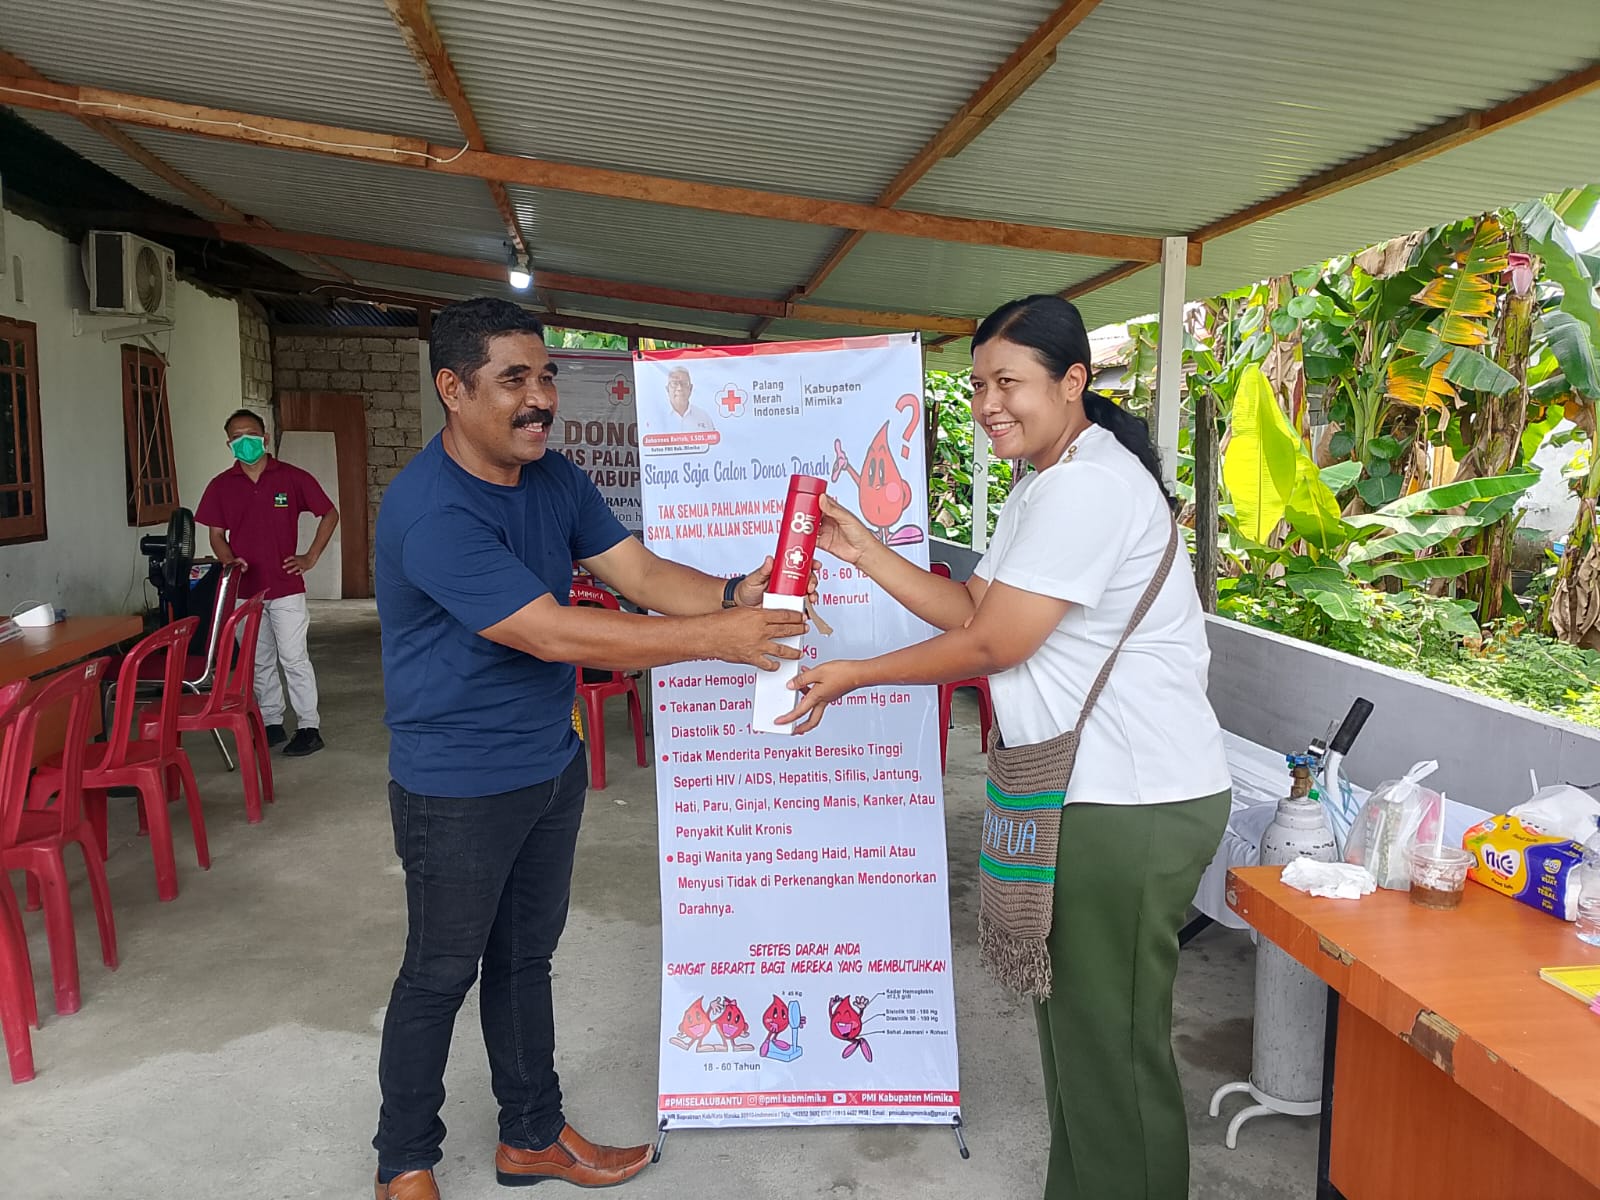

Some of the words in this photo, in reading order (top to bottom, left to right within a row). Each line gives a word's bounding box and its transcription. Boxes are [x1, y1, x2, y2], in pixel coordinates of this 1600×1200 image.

[752, 380, 784, 391] Palang
[753, 394, 782, 404] Merah
[804, 396, 842, 406] Mimika
[754, 405, 800, 416] Indonesia
[645, 463, 679, 489] Siapa
[683, 461, 709, 488] Saja
[714, 460, 747, 482] Calon
[751, 458, 787, 480] Donor
[791, 454, 830, 476] Darah
[658, 505, 675, 519] TAK
[677, 502, 709, 519] SEMUA
[711, 499, 760, 517] PAHLAWAN
[647, 526, 674, 541] SAYA,
[676, 523, 705, 540] KAMU,
[707, 522, 740, 537] KALIAN
[743, 520, 774, 536] SEMUA
[839, 567, 853, 579] 60
[822, 592, 869, 605] Menurut
[802, 645, 817, 659] Kg
[668, 675, 702, 688] Kadar
[705, 672, 757, 688] Hemoglo
[670, 701, 716, 713] Tekanan
[719, 698, 752, 711] Darah
[846, 693, 867, 705] mm
[870, 692, 886, 707] Hg
[889, 691, 910, 704] dan
[672, 724, 719, 738] Diastolik
[722, 723, 736, 736] 50
[672, 751, 703, 763] Tidak
[705, 748, 760, 761] Menderita
[763, 746, 812, 761] Penyakit
[814, 744, 865, 758] Beresiko
[867, 742, 904, 758] Tinggi
[673, 775, 713, 790] Seperti
[715, 774, 736, 786] HIV
[744, 772, 776, 786] AIDS,
[779, 770, 832, 786] Hepatitis,
[834, 769, 870, 783] Sifilis,
[872, 768, 923, 782] Jantung,
[674, 801, 701, 813] Hati,
[703, 800, 732, 812] Paru,
[735, 798, 771, 813] Ginjal,
[773, 796, 820, 811] Kencing
[823, 795, 860, 808] Manis,
[863, 794, 906, 806] Kanker,
[909, 793, 936, 805] Atau
[676, 825, 723, 840] Penyakit
[726, 824, 752, 836] Kulit
[755, 822, 793, 835] Kronis
[983, 808, 1037, 855] PAPUA
[677, 851, 702, 866] Bagi
[704, 850, 742, 863] Wanita
[745, 851, 773, 864] yang
[776, 848, 819, 862] Sedang
[821, 847, 851, 860] Haid,
[853, 845, 887, 858] Hamil
[889, 845, 916, 857] Atau
[678, 876, 724, 891] Menyusi
[727, 875, 757, 887] Tidak
[760, 874, 771, 887] di
[774, 872, 854, 888] Perkenangkan
[858, 871, 937, 885] Mendonorkan
[679, 902, 735, 917] Darahnya.
[749, 944, 791, 957] SETETES
[795, 943, 829, 956] DARAH
[834, 943, 861, 955] ANDA
[667, 962, 706, 976] SANGAT
[711, 961, 756, 975] BERARTI
[760, 961, 786, 974] BAGI
[791, 960, 833, 974] MEREKA
[837, 959, 863, 973] YANG
[867, 959, 946, 973] MEMBUTUHKAN
[704, 1063, 713, 1071] 18
[721, 1062, 731, 1071] 60
[733, 1062, 761, 1071] Tahun
[665, 1097, 742, 1107] #PMISELALUBANTU
[862, 1094, 876, 1102] PMI
[878, 1094, 921, 1105] Kabupaten
[924, 1093, 954, 1103] Mimika
